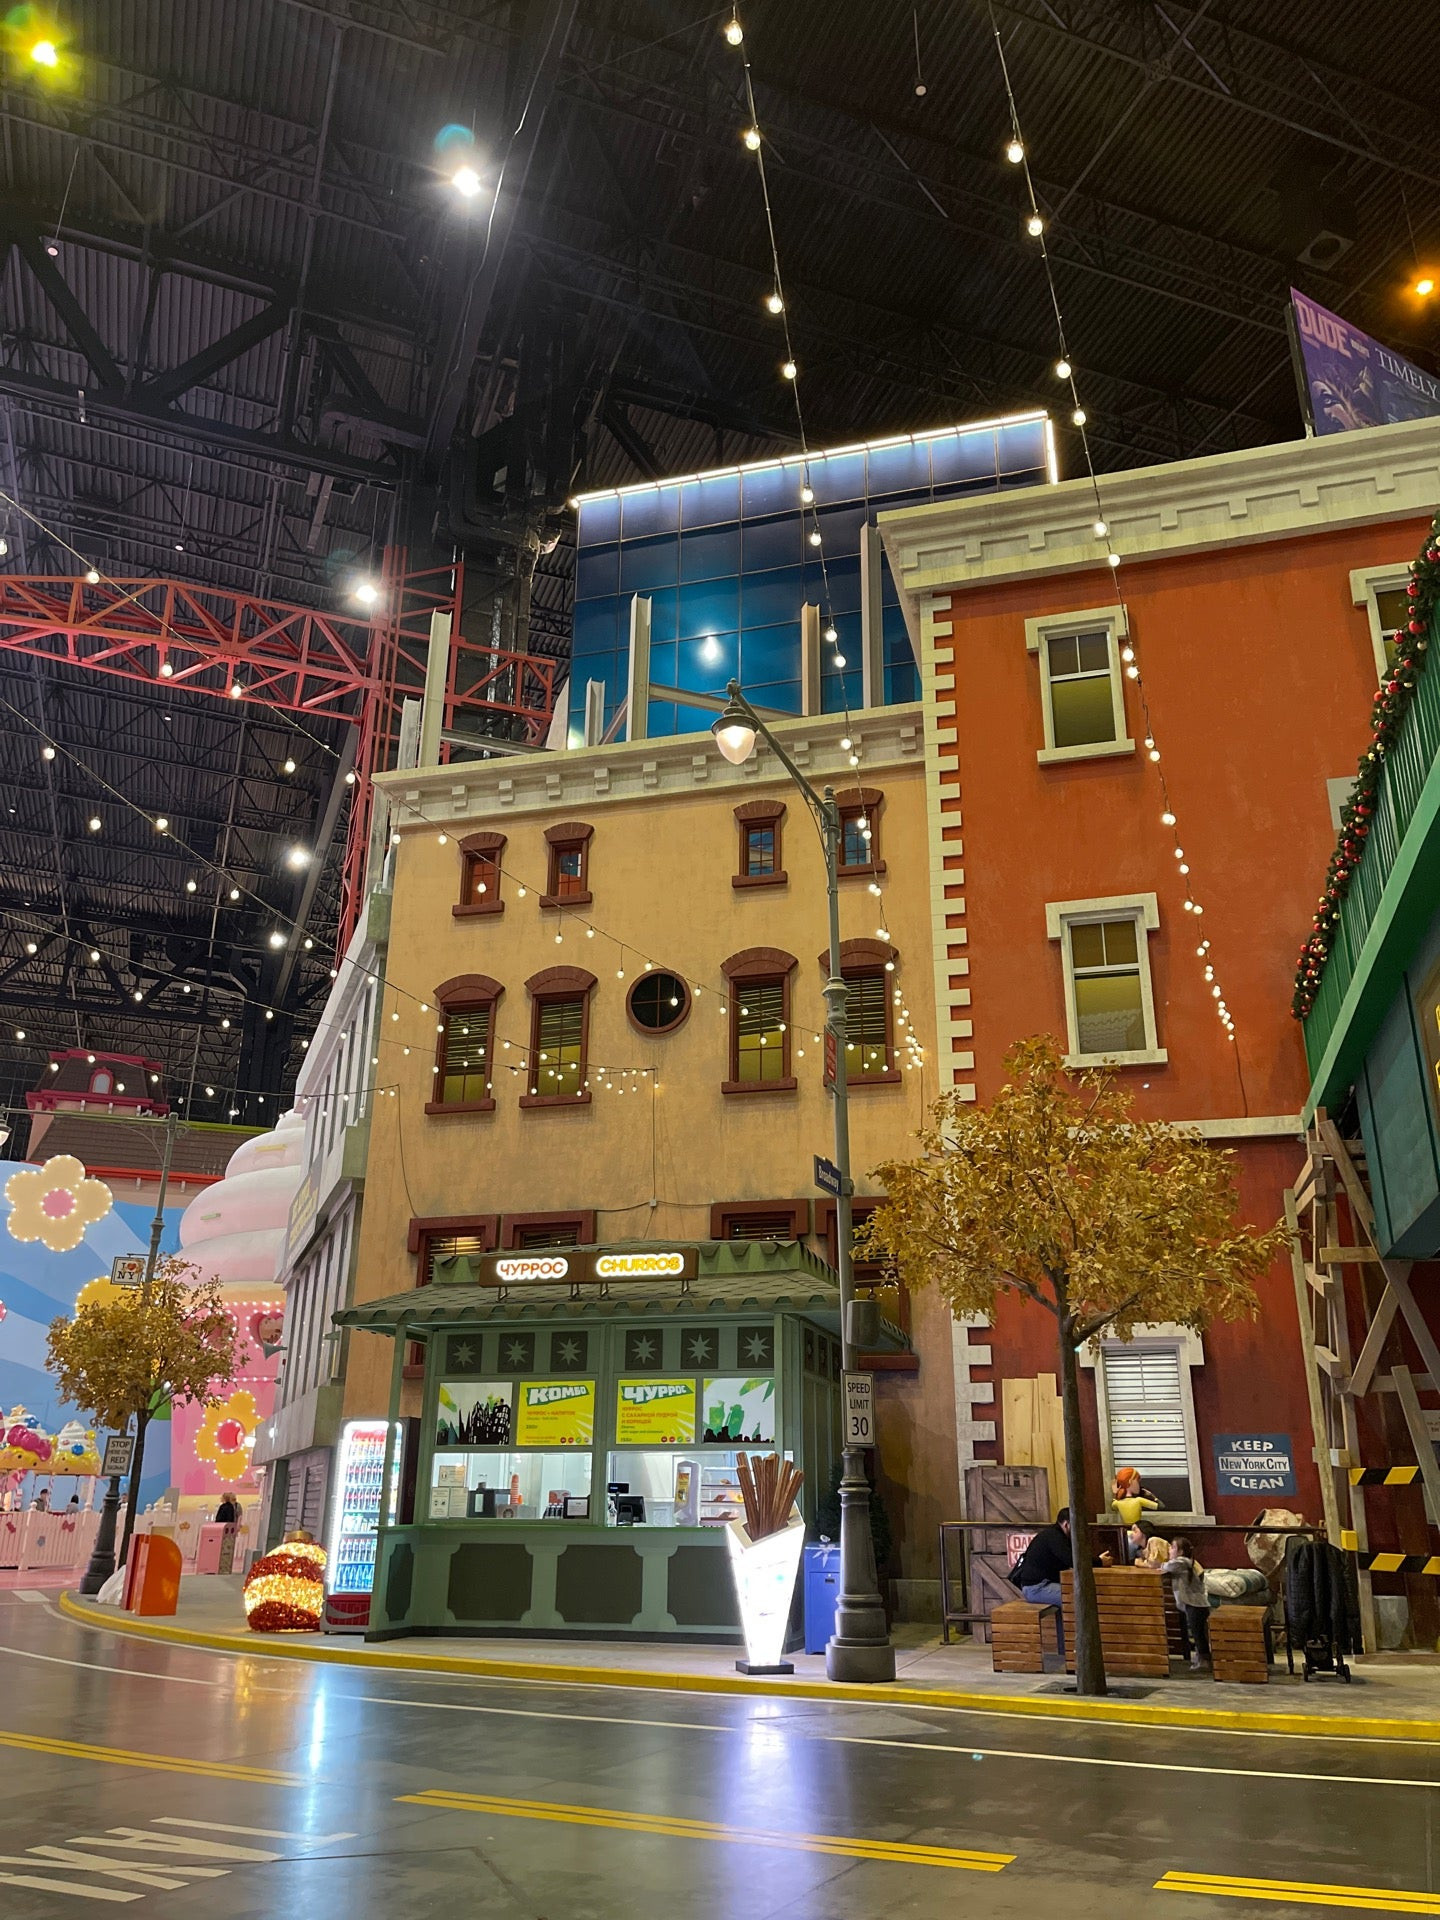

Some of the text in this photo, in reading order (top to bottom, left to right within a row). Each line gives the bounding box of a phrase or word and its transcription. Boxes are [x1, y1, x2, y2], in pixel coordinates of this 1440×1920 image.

[1296, 298, 1352, 359] DUDE
[1375, 348, 1438, 399] TIMELY
[500, 1261, 564, 1277] ЧУРРОС
[600, 1256, 680, 1273] CHURROS
[117, 1271, 135, 1280] NY
[528, 1386, 588, 1406] КОМБО
[623, 1385, 687, 1403] ЧУРРОС
[847, 1382, 871, 1394] SPEED
[849, 1399, 870, 1410] LIMIT
[851, 1416, 869, 1437] 30
[1231, 1440, 1274, 1452] KEEP
[110, 1456, 126, 1464] RED
[1230, 1476, 1285, 1490] CLEAN
